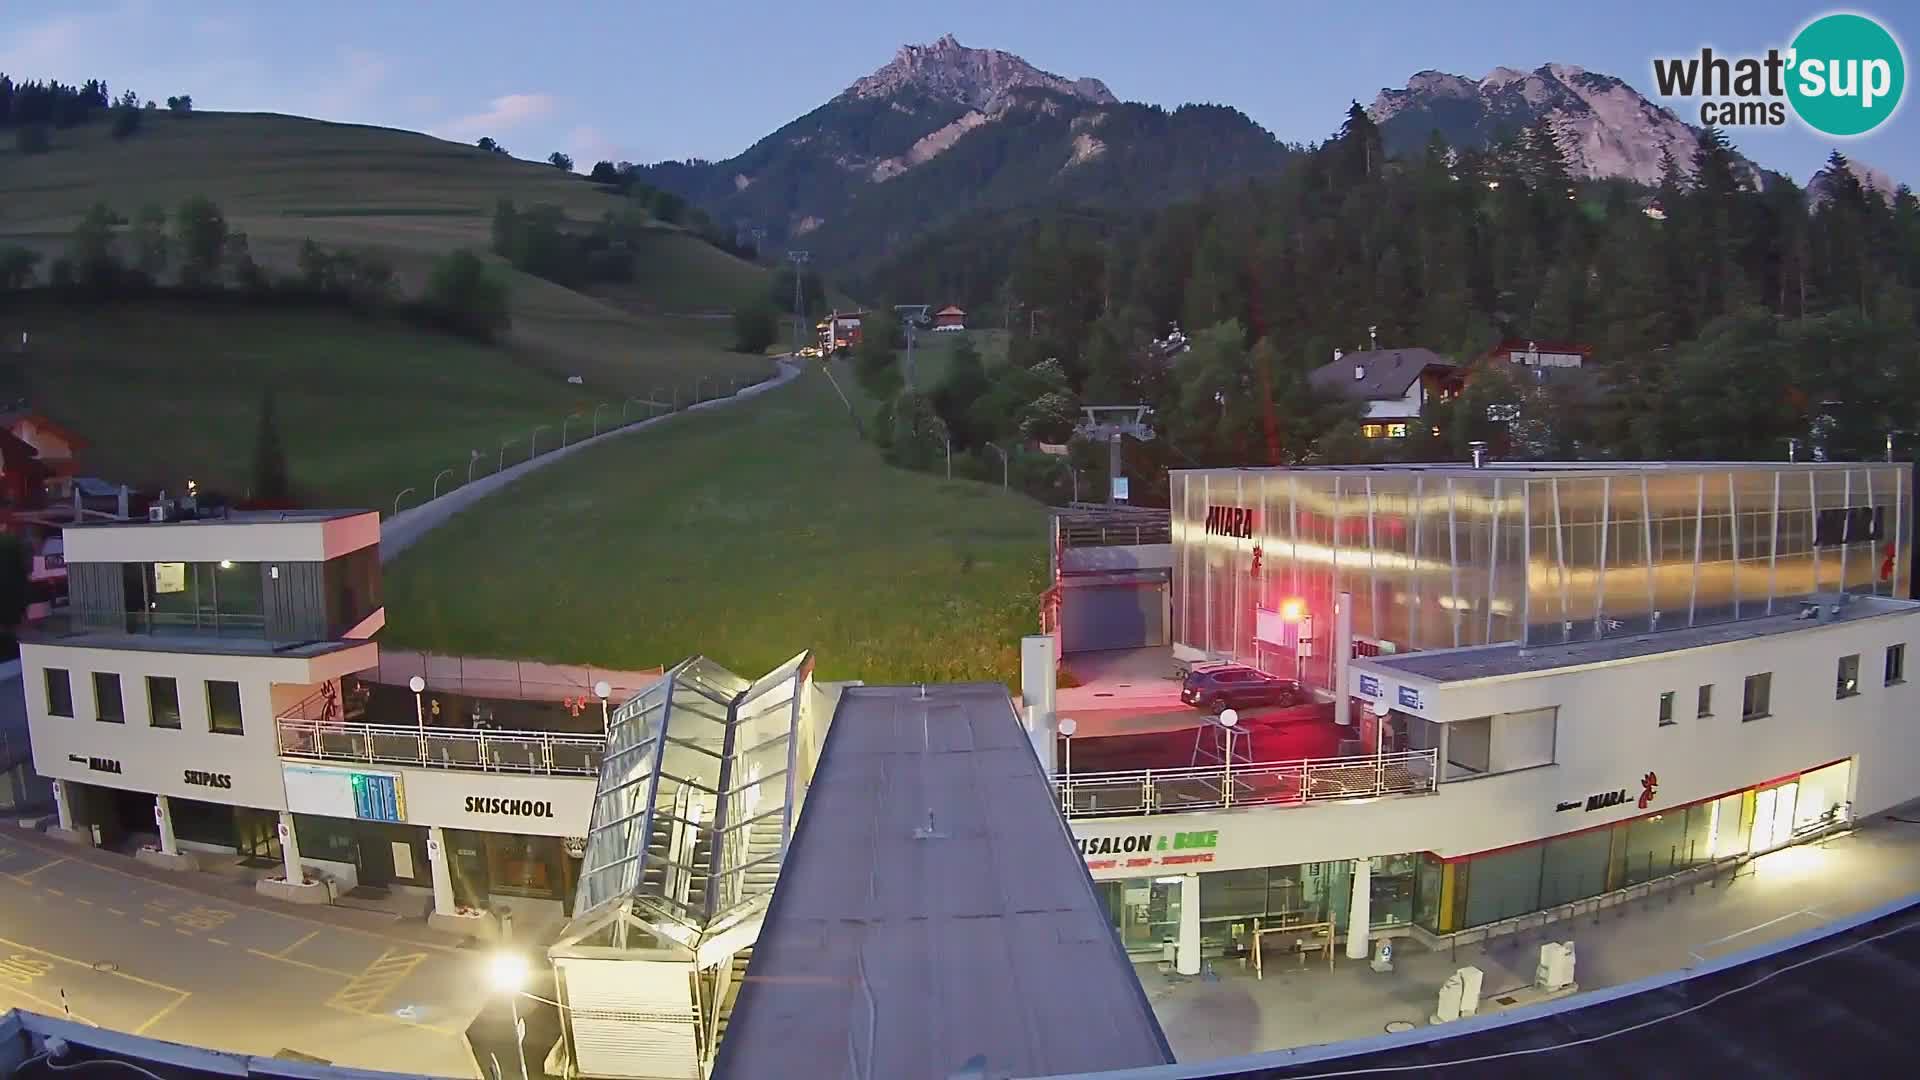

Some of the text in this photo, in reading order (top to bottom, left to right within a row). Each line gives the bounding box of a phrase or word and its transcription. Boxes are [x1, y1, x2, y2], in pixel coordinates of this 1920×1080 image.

[1206, 505, 1253, 539] MIARA
[184, 769, 232, 789] SKIPASS
[464, 796, 554, 818] SKISCHOOL
[1585, 789, 1626, 812] MIARA
